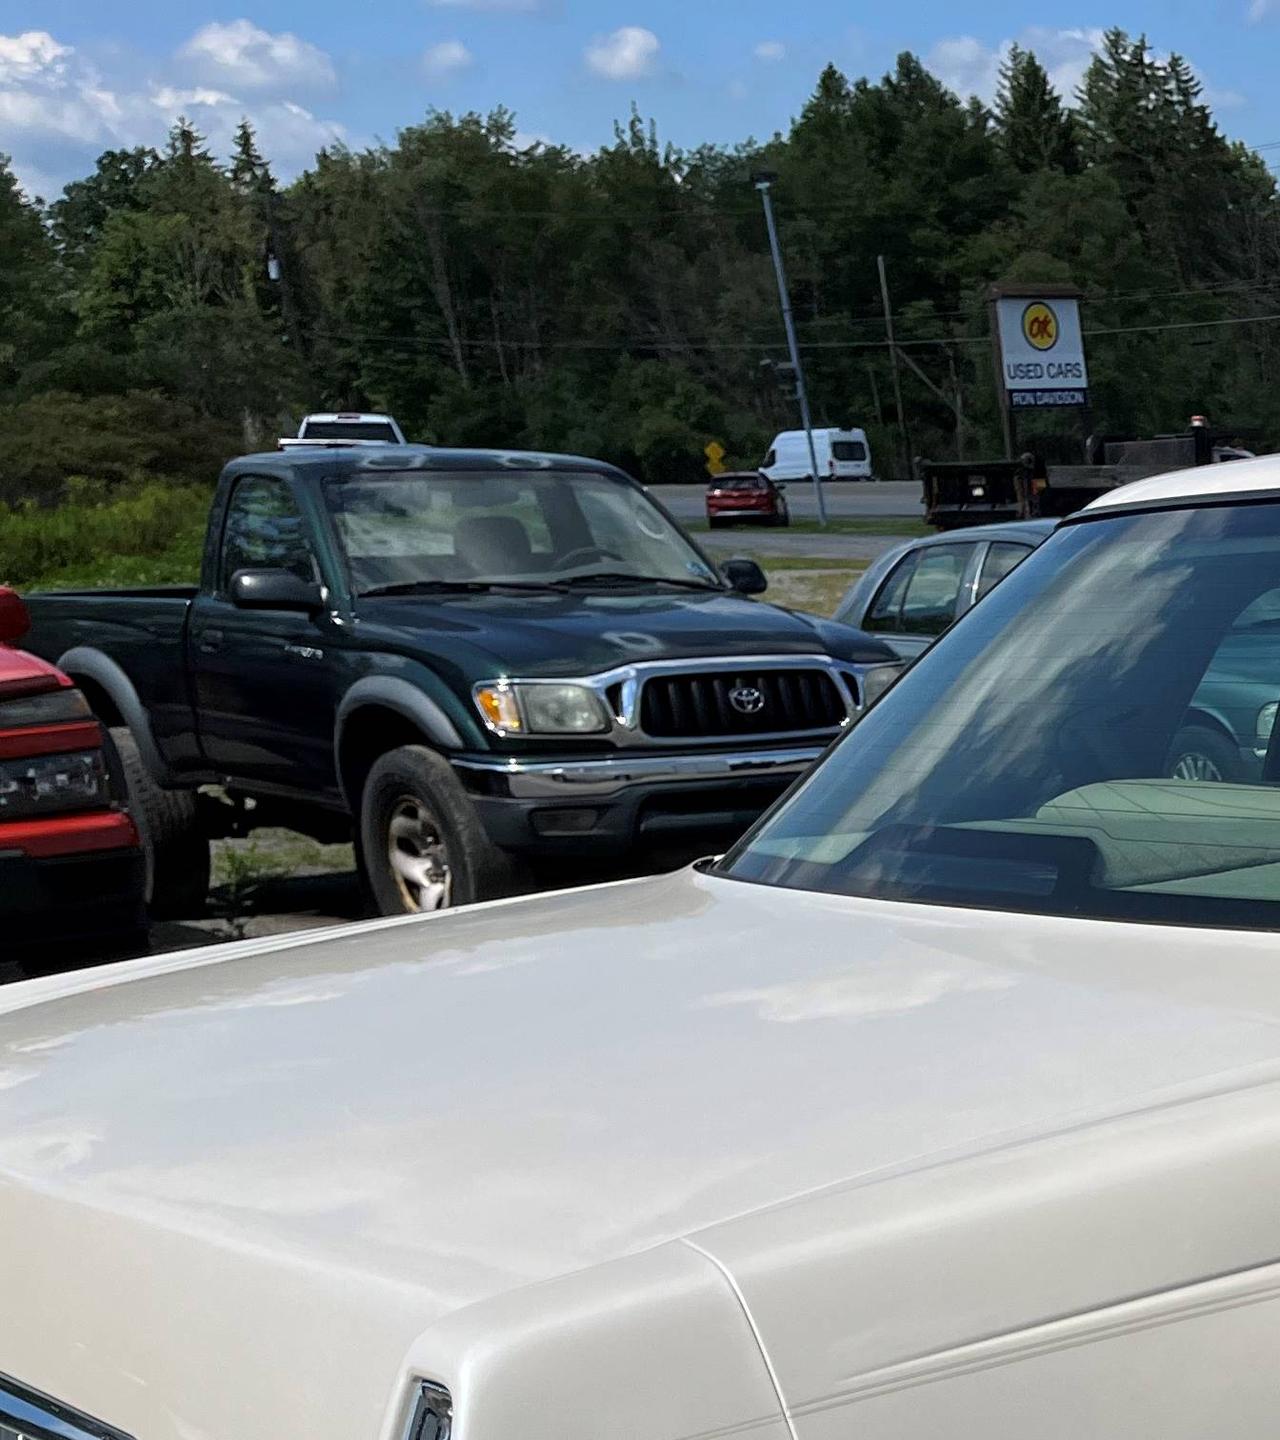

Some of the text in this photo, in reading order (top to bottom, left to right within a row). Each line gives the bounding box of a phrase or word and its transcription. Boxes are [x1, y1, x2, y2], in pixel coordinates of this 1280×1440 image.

[1029, 315, 1052, 338] OK
[1007, 362, 1082, 379] USED CARS
